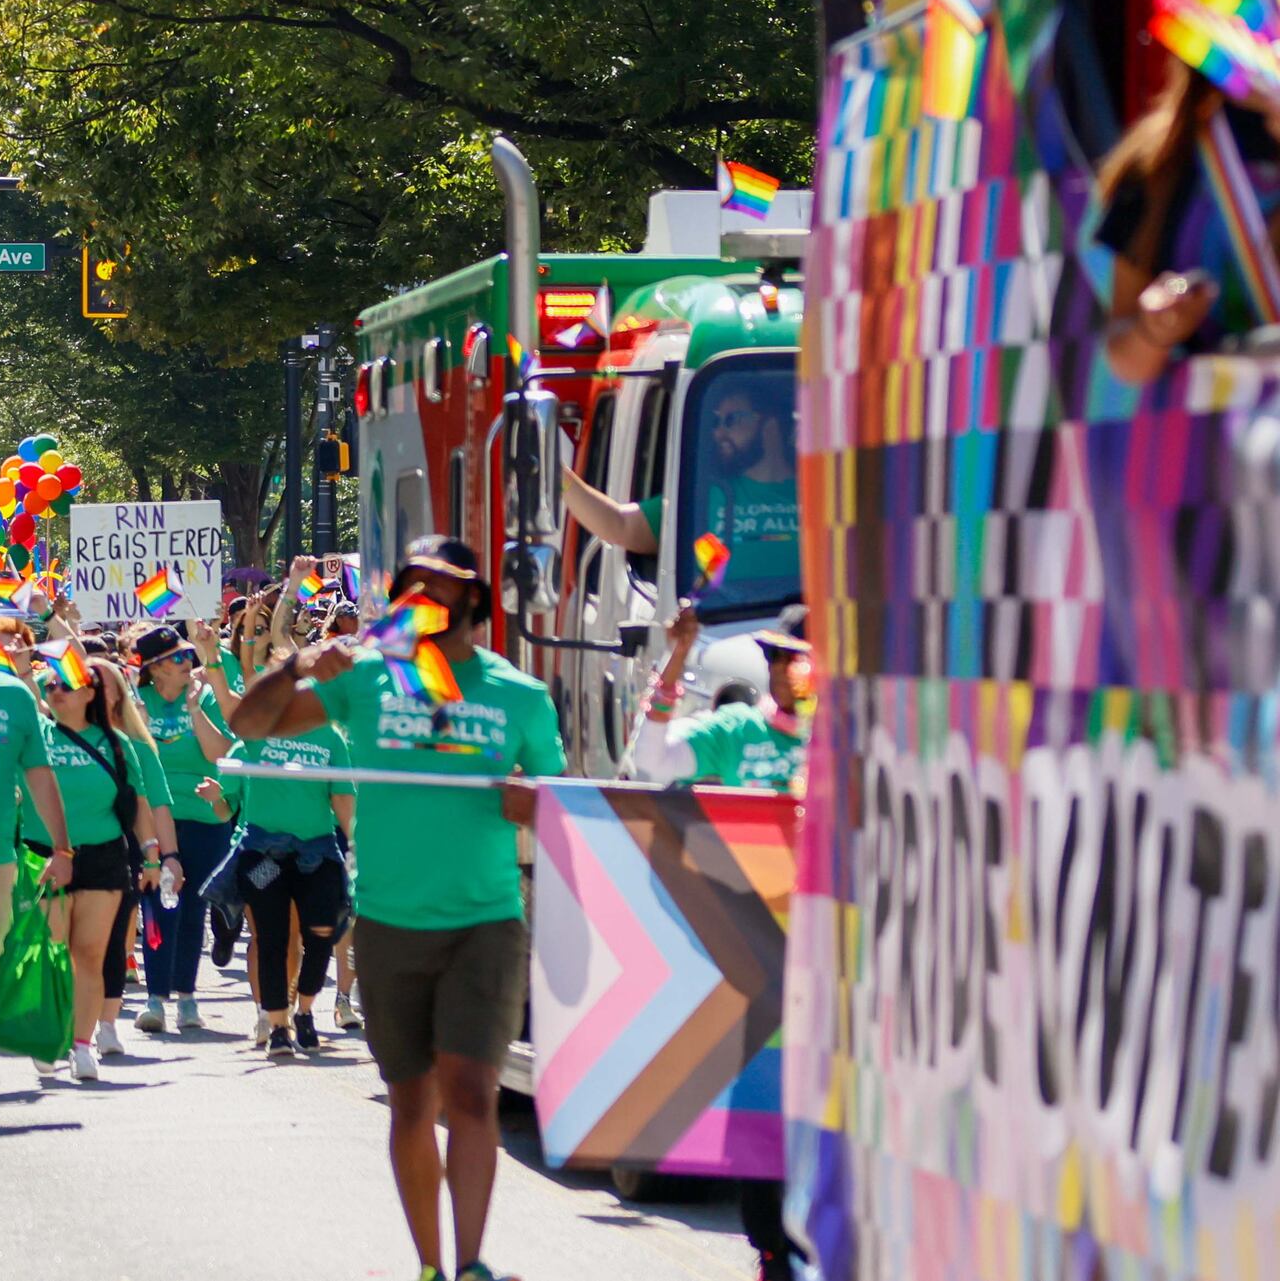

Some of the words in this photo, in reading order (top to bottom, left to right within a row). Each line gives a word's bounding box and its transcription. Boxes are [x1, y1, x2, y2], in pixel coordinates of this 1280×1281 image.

[116, 505, 166, 530] RNN
[76, 527, 223, 563] REGISTERED
[378, 714, 432, 738] FOR
[260, 747, 289, 761] FOR
[291, 753, 320, 766] ALL
